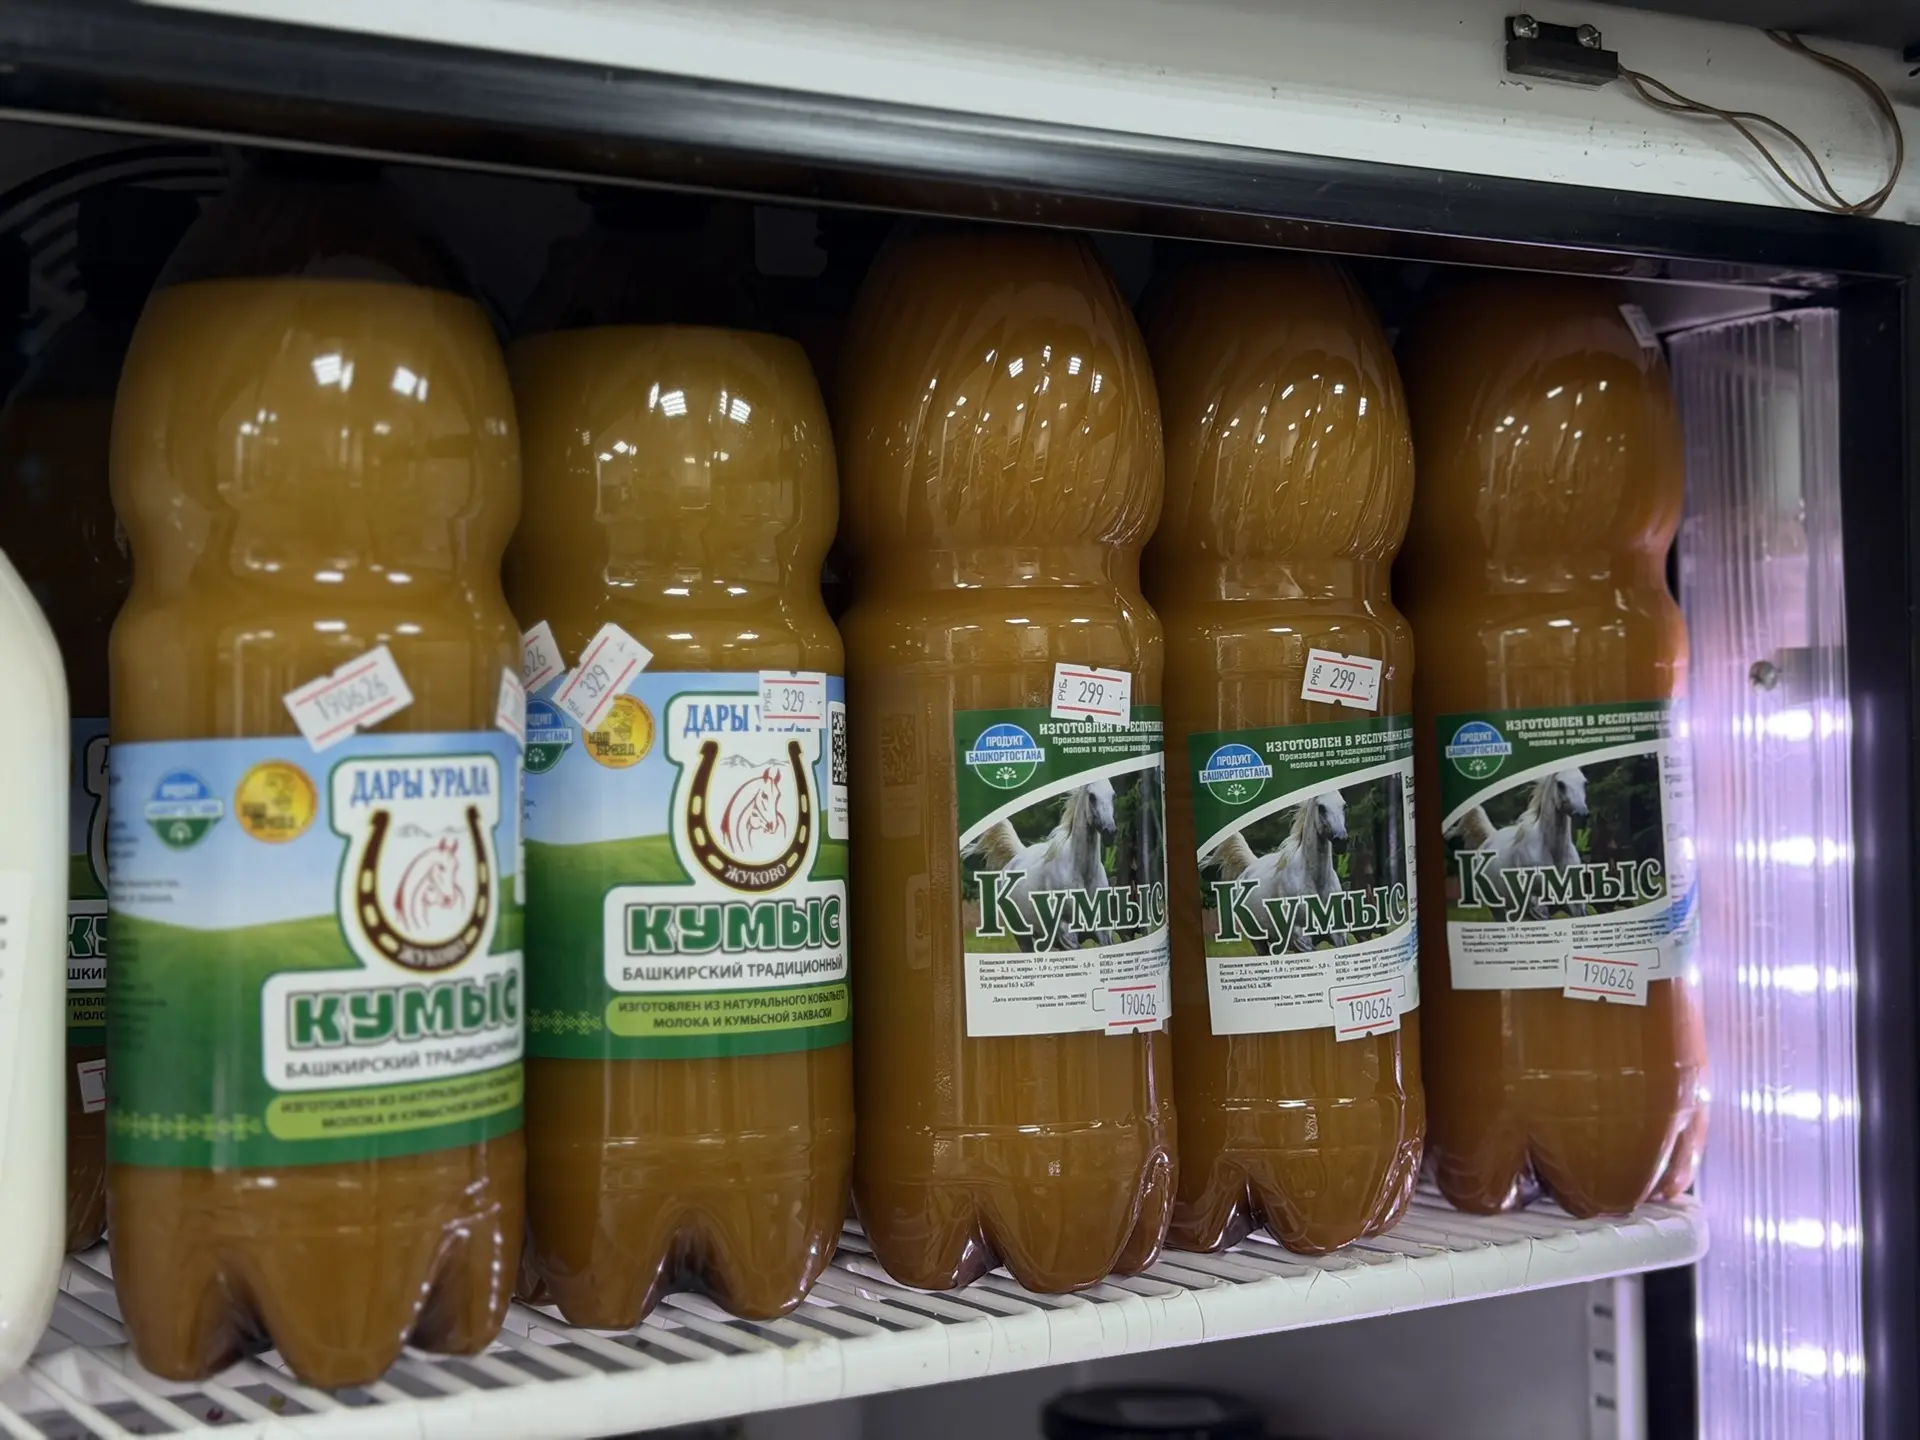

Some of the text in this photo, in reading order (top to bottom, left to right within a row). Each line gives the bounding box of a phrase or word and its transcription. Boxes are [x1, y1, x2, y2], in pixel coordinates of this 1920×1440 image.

[579, 664, 611, 698] 329
[1330, 667, 1356, 691] 299
[314, 674, 390, 721] 190626
[782, 688, 805, 712] 329
[1078, 681, 1104, 705] 299
[683, 704, 749, 738] ДАРЫ
[1039, 721, 1113, 735] ИЗГОТОВЛЕН
[1506, 715, 1584, 731] ИЗГОТОВЛЕН
[1587, 715, 1595, 726] В
[986, 735, 1024, 748] ПРОДУКТ
[1052, 735, 1096, 746] Произведен
[1063, 746, 1090, 754] молока
[1266, 735, 1342, 753] ИЗГОТОВЛЕН
[1345, 735, 1352, 746] В
[968, 750, 1042, 763] БАШКОРТОСТАНА
[1216, 753, 1252, 766] ПРОДУКТ
[1279, 750, 1324, 762] Произведен
[1290, 761, 1318, 769] молока
[350, 765, 491, 807] ДАРЫ УРАЛА
[1202, 766, 1270, 782] БАШКОРТОСТАНА
[725, 862, 787, 885] ЖУКОВО
[1454, 849, 1663, 923] Кумыс
[974, 870, 1166, 952] Кумыс
[1211, 877, 1406, 956] Кумыс
[625, 896, 842, 954] КУМЫС
[622, 955, 843, 981] БАШКИРСКИЙ ТРАДИЦИОННЫЙ
[1584, 963, 1634, 990] 190626
[286, 968, 518, 1051] КУМЫС
[618, 990, 845, 1013] ИЗГОТОВЛЕН ИЗ НАТУРАЛЬНОГО КОБЫЛЬЕГО
[1121, 993, 1157, 1015] 190626
[1349, 997, 1392, 1021] 190626
[654, 1007, 832, 1029] МОЛОКА И КУМЫСНОЙ ЗАКВАСКИ
[286, 1053, 419, 1078] БАШКИРСКИЙ
